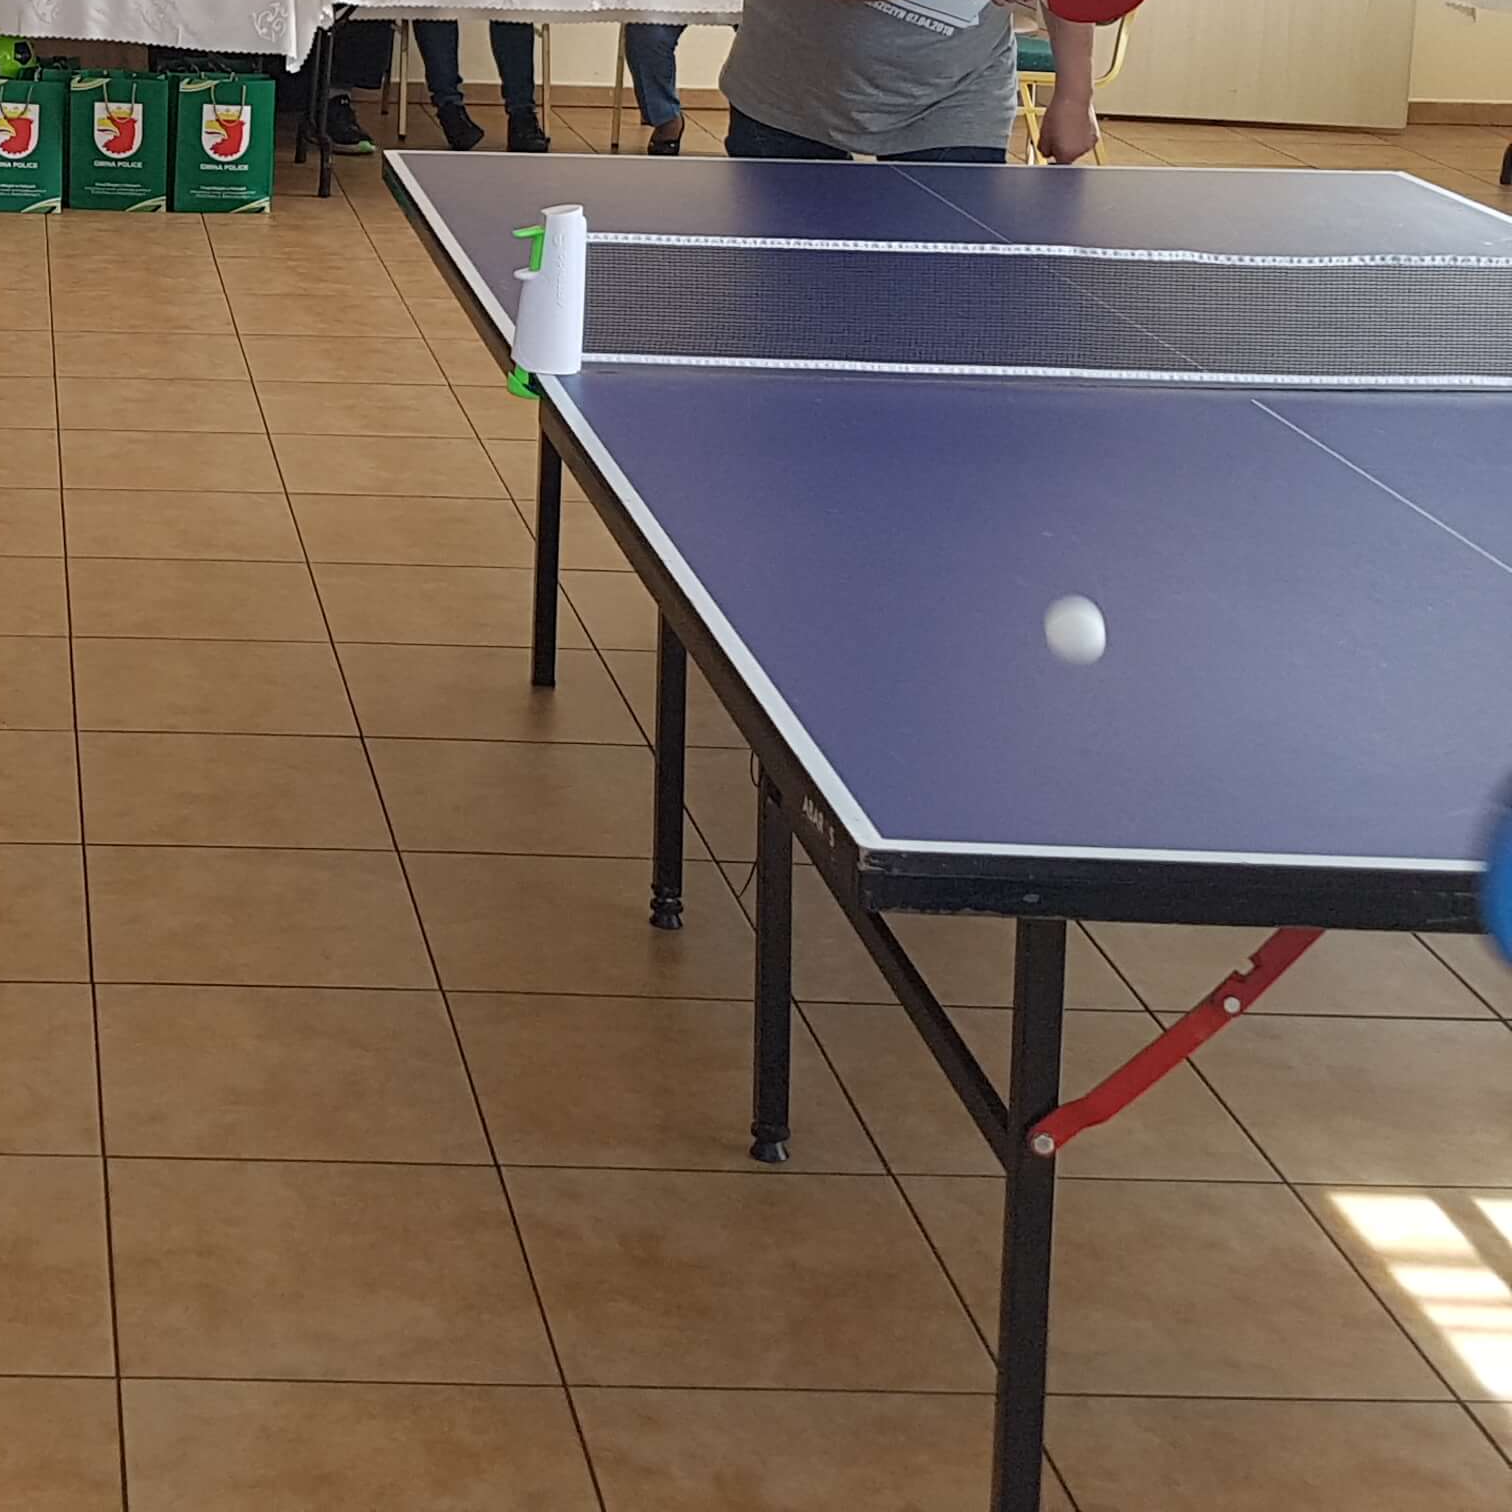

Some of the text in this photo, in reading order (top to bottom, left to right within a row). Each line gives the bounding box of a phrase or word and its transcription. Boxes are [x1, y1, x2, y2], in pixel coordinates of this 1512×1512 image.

[12, 161, 38, 169] POLICE
[117, 161, 143, 169] POLICE
[224, 163, 248, 171] POLICE
